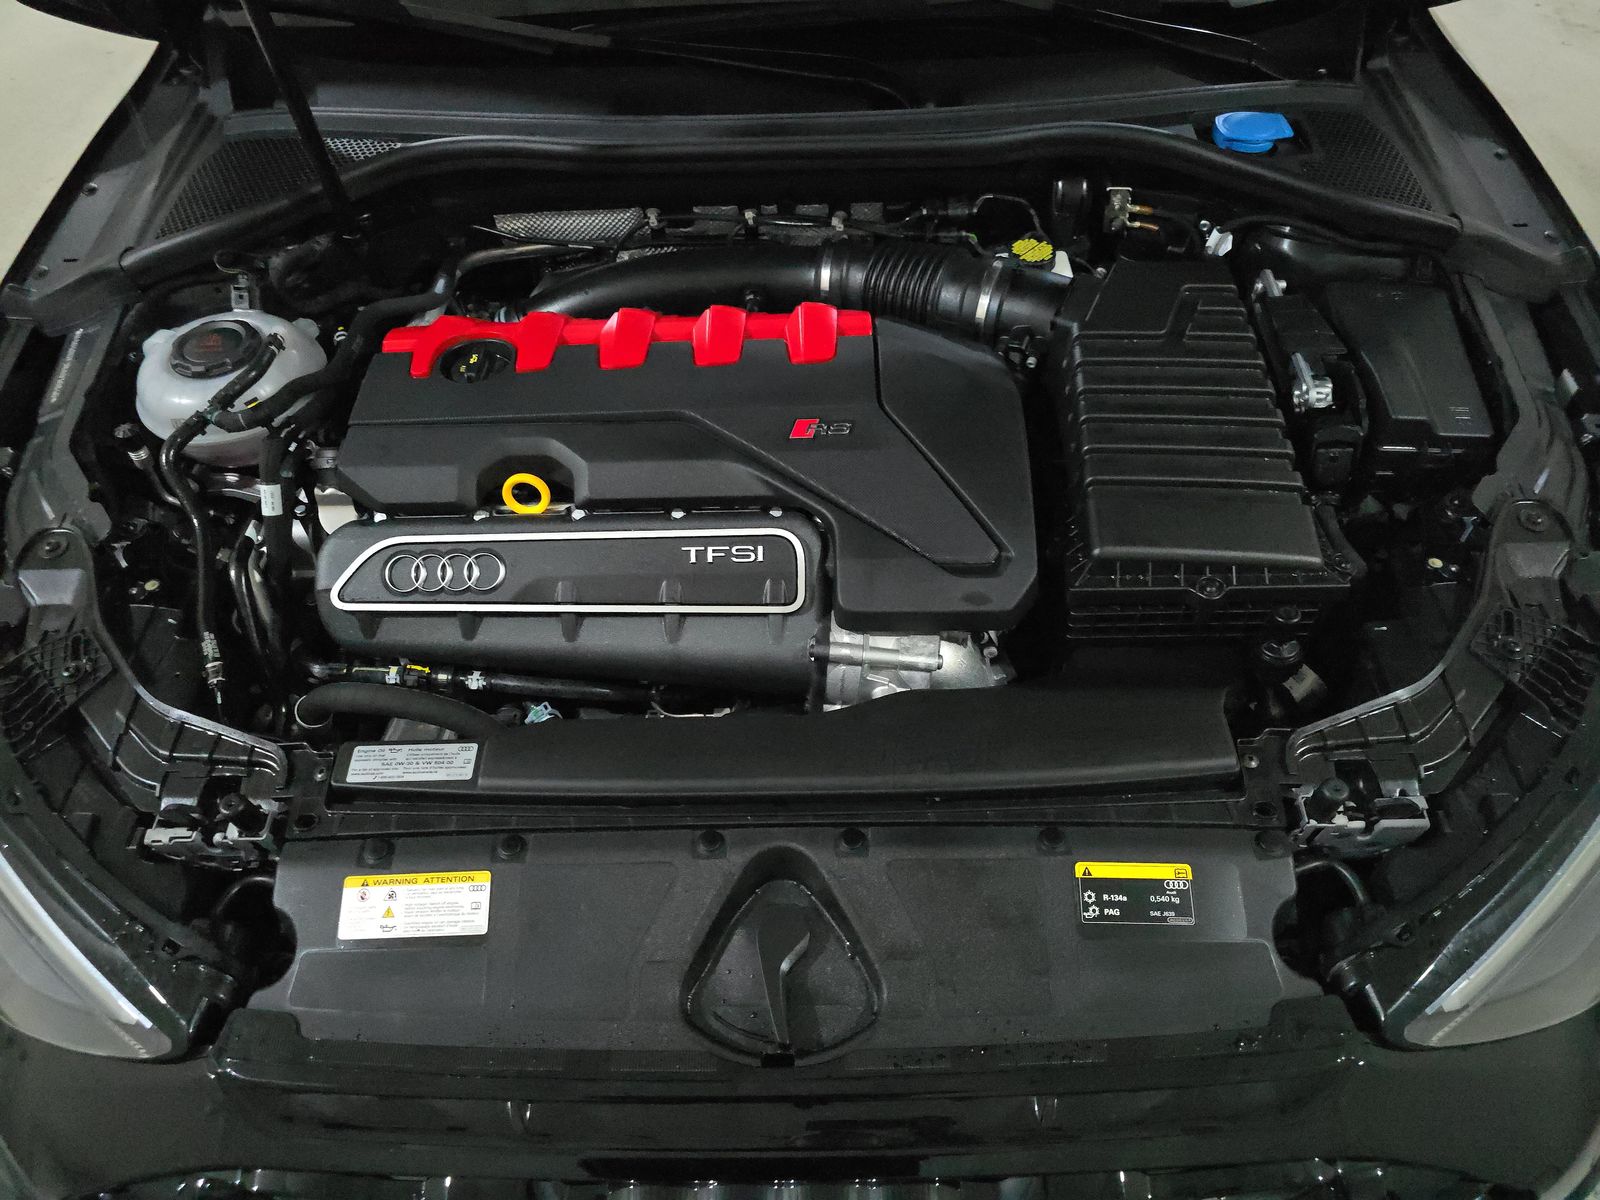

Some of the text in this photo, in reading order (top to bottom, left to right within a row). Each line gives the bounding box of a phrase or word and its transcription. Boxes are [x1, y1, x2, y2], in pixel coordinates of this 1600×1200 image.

[681, 545, 764, 563] TFSI
[373, 875, 475, 886] WARNING ATTENTION
[1149, 895, 1180, 904] 0,540 kg
[1104, 908, 1120, 916] PAG
